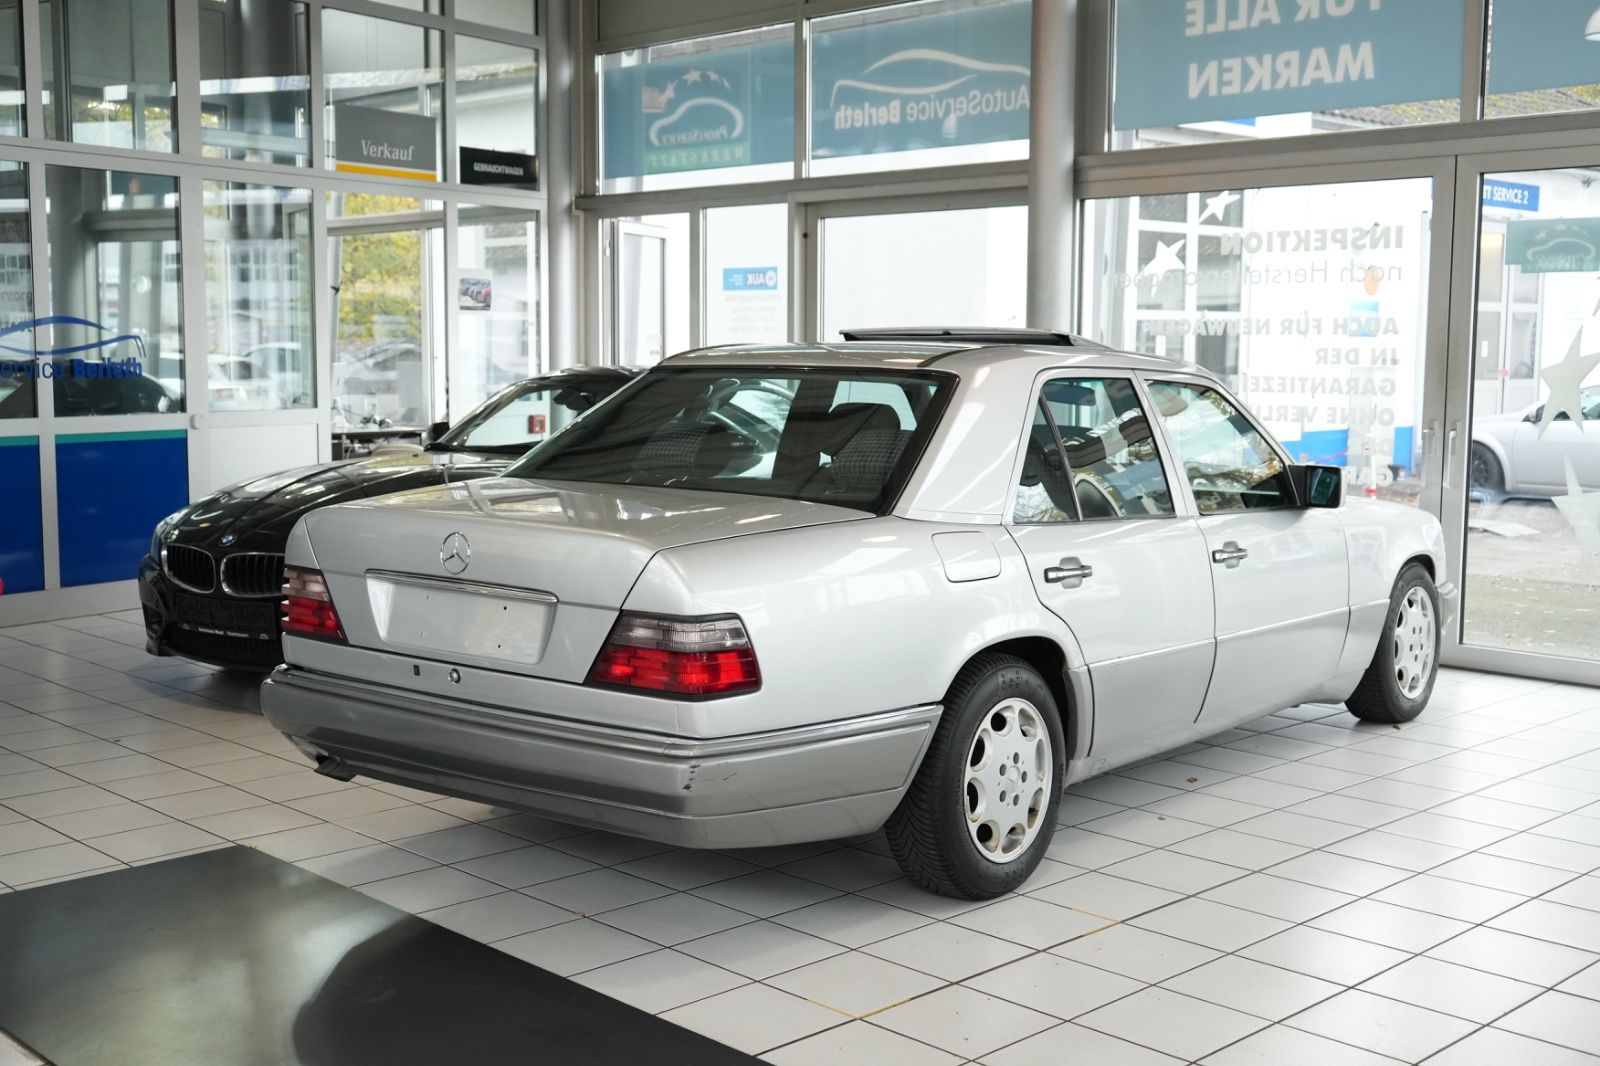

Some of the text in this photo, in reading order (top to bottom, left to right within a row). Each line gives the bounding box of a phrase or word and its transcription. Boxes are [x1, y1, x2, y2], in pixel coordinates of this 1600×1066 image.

[360, 139, 415, 161] Verkauf
[1493, 186, 1523, 204] SERVICE
[1523, 190, 1529, 205] 2
[0, 356, 64, 380] ervice
